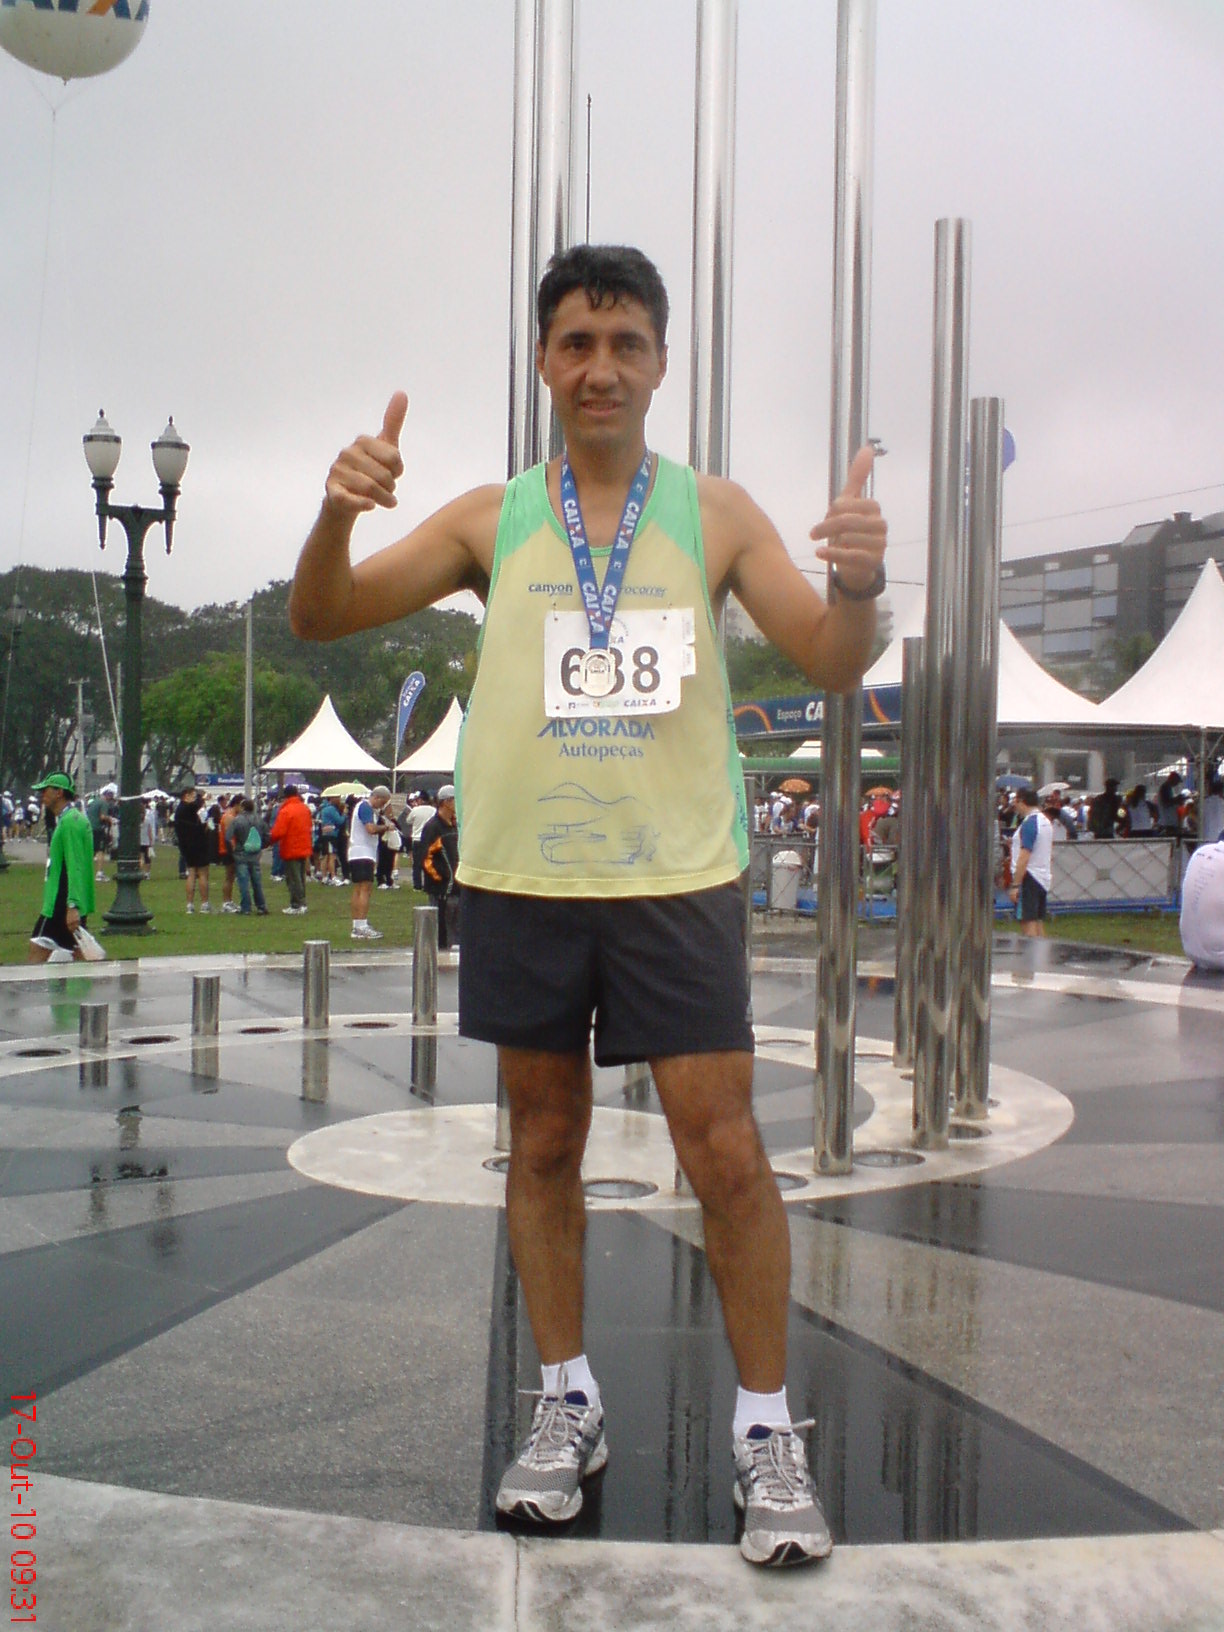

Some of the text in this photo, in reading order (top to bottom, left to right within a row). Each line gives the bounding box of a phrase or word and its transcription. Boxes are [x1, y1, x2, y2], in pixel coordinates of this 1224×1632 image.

[564, 499, 585, 548] CAIXA
[616, 501, 640, 550] CAIXA
[528, 583, 573, 596] canyon
[582, 582, 605, 634] CAIXA
[601, 584, 617, 630] CAI
[624, 699, 656, 708] CAIXA
[777, 709, 801, 722] Espaço
[537, 718, 655, 740] ALVORADA
[559, 742, 644, 762] Autopeças
